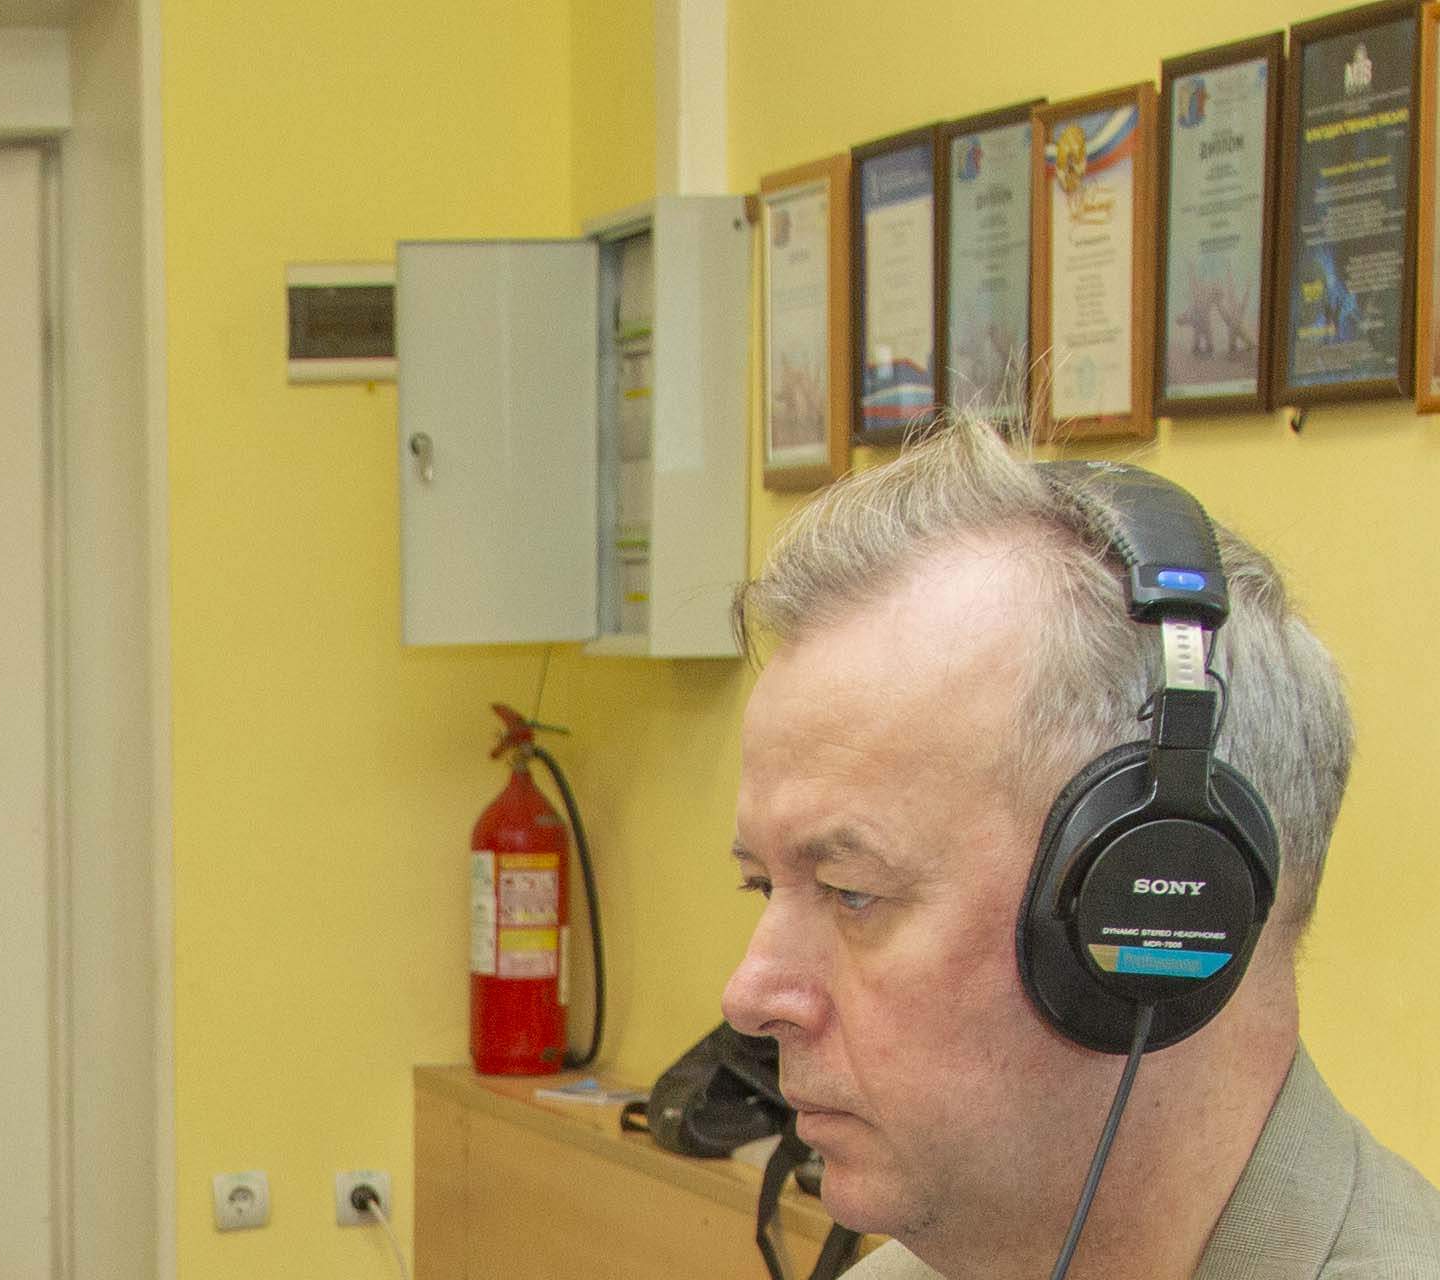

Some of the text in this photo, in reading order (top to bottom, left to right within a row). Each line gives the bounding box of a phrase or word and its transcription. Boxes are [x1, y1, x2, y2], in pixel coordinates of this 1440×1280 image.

[1133, 878, 1206, 896] SONY
[1102, 927, 1226, 940] DYNAMIC STEREO HEADPHONES
